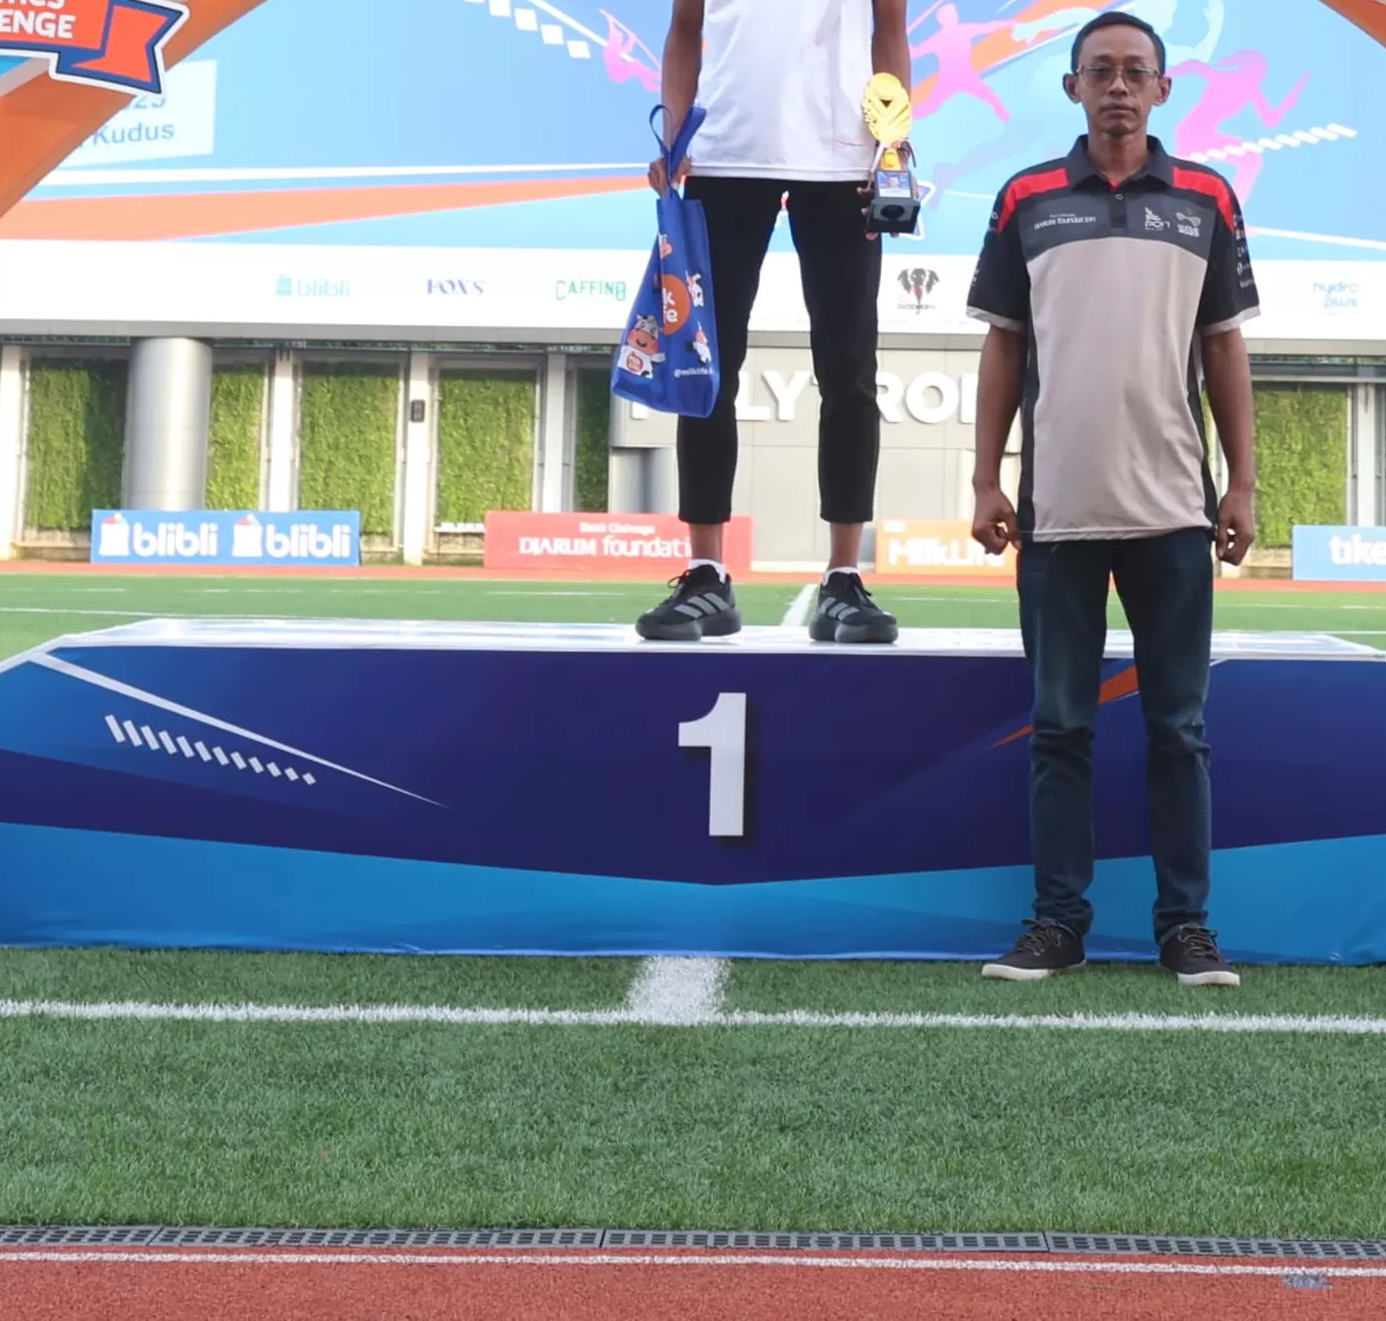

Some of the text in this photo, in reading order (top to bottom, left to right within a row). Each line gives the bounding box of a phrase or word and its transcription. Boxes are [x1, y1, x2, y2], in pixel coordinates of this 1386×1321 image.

[132, 522, 218, 558] blibli
[265, 523, 351, 559] blibli
[519, 535, 693, 558] DJARUM foundati
[678, 692, 746, 836] 1
